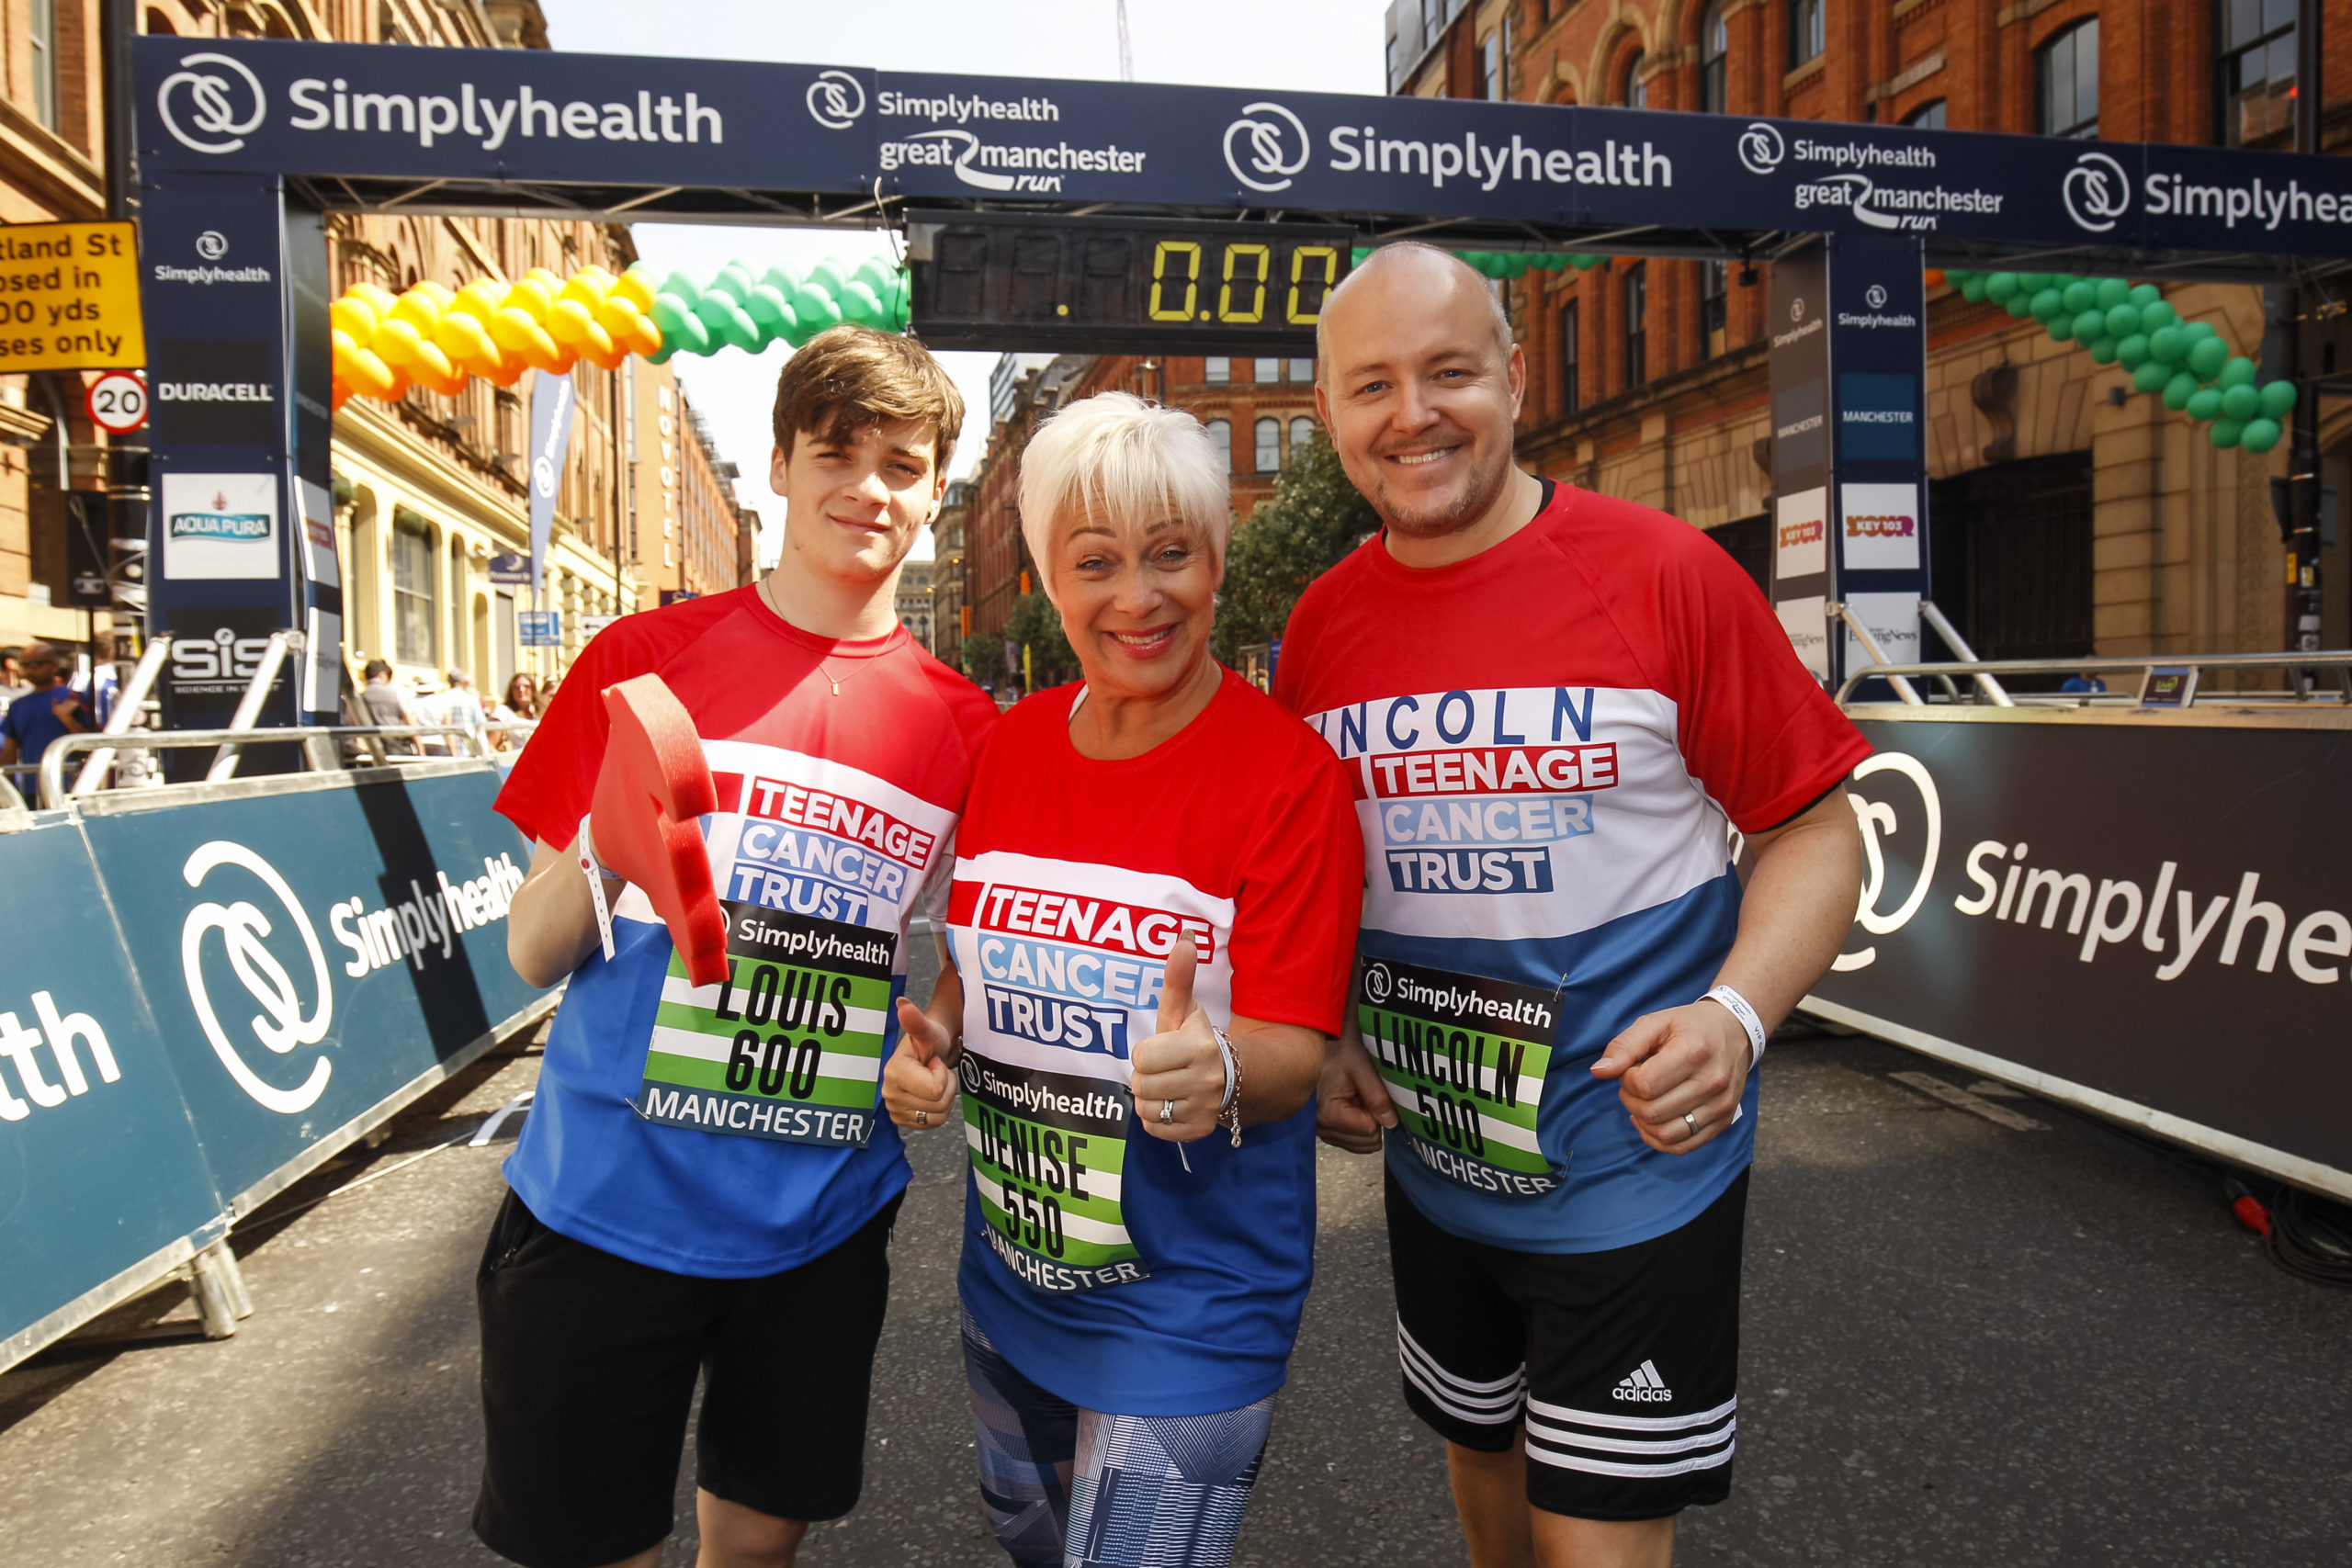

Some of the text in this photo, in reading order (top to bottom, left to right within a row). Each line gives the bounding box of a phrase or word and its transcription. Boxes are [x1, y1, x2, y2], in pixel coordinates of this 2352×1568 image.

[288, 77, 723, 150] Simplyhealth
[877, 91, 1059, 124] Simplyhealth
[879, 138, 1147, 173] great manchester
[1329, 125, 1672, 191] Simplyhealth
[1794, 140, 1936, 169] Simplyhealth
[1015, 175, 1062, 193] run
[1795, 182, 2003, 213] great manchester
[87, 233, 122, 257] St
[1901, 214, 1938, 230] run
[74, 266, 101, 288] in
[154, 265, 271, 285] Simplyhealth
[48, 299, 100, 325] yds
[1838, 312, 1916, 329] Simplyhealth
[56, 330, 121, 356] only
[97, 389, 140, 414] 20
[159, 383, 274, 401] DURACELL
[1778, 415, 1823, 438] MANCHESTER
[1843, 412, 1913, 423] MANCHESTER
[659, 385, 674, 568] NOVOTEL
[174, 515, 268, 536] AQUA PURA
[1857, 521, 1903, 531] KEY 103
[1374, 748, 1614, 795] TEENAGE
[755, 778, 935, 868] TEENAGE
[1385, 798, 1591, 843] CANCER
[741, 825, 906, 900] CANCER
[1388, 851, 1544, 890] TRUST
[330, 852, 525, 978] Simplyhealth
[735, 866, 868, 926] TRUST
[1954, 840, 2352, 985] Simplyhe
[739, 919, 889, 966] Simplyhealth
[989, 888, 1213, 961] TEENAGE
[716, 959, 852, 1038] LOUIS
[988, 989, 1124, 1055] TRUST
[1396, 977, 1552, 1029] Simplyhealth
[725, 1030, 821, 1100] 600
[1374, 1011, 1525, 1109] LINCOLN
[645, 1088, 864, 1142] MANCHESTER
[983, 1070, 1124, 1121] Simplyhealth
[1415, 1084, 1485, 1158] 500
[978, 1104, 1090, 1202] DENISE
[1412, 1136, 1557, 1195] ANCHESTER
[1002, 1179, 1064, 1258] 550
[1612, 1386, 1672, 1402] adidas
